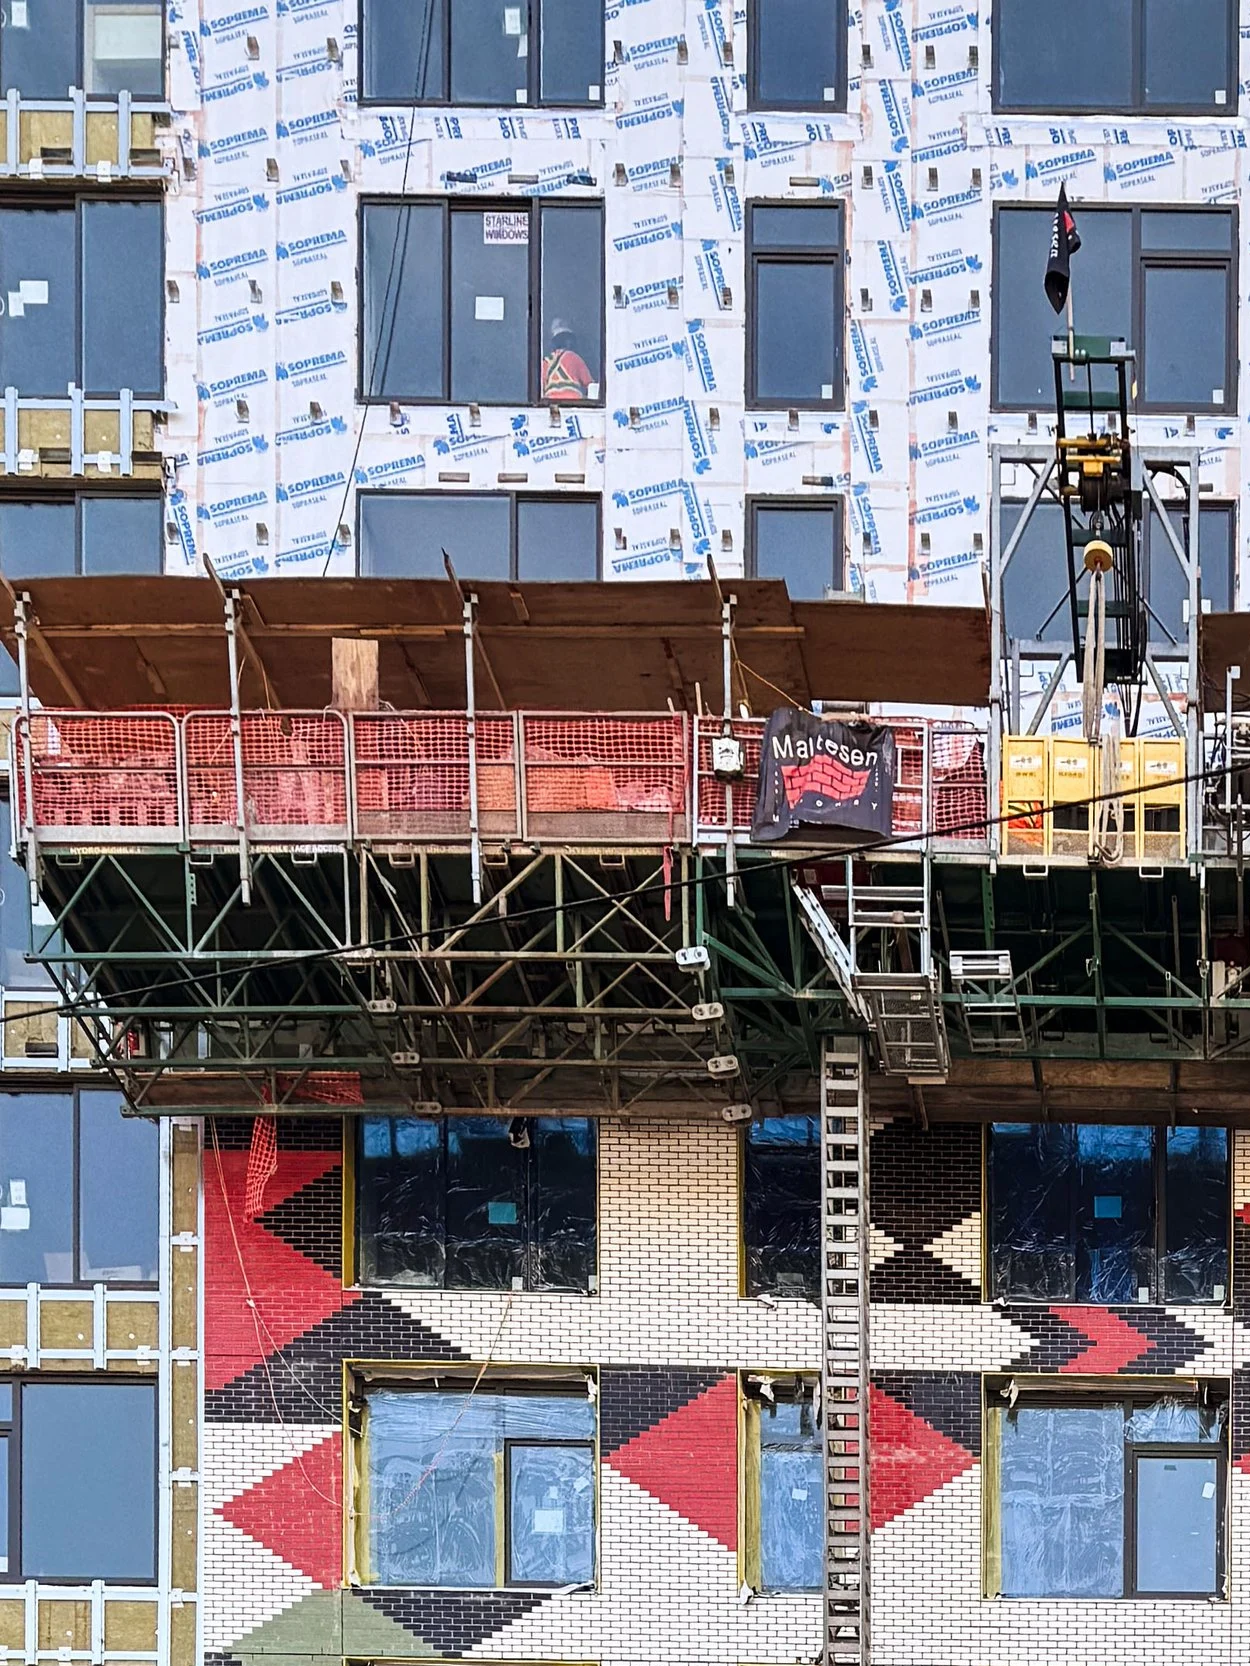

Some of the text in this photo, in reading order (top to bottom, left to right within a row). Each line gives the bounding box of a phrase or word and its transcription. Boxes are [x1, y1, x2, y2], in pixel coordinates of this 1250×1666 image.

[210, 6, 268, 28] SOPREMA
[289, 110, 337, 129] SOPREM
[617, 108, 672, 129] SOPREMA
[210, 128, 267, 149] SOPREMA
[1038, 149, 1095, 171] SOPREMA
[1116, 152, 1174, 173] SOPREMA
[288, 230, 346, 251] SOPREMA
[615, 229, 672, 251] SOPREMA
[210, 249, 267, 270] SOPREMA
[288, 351, 345, 371] SOPREMA
[615, 350, 672, 371] SOPREMA
[210, 369, 267, 391] SOPREMA
[638, 396, 685, 415] OPREMA
[921, 431, 978, 451] SOPREMA
[368, 455, 424, 475] SOPREMA
[288, 472, 345, 493] SOPREMA
[210, 491, 267, 512] SOPREMA
[613, 552, 670, 573] SOPREMA
[772, 735, 877, 766] Maltesen
